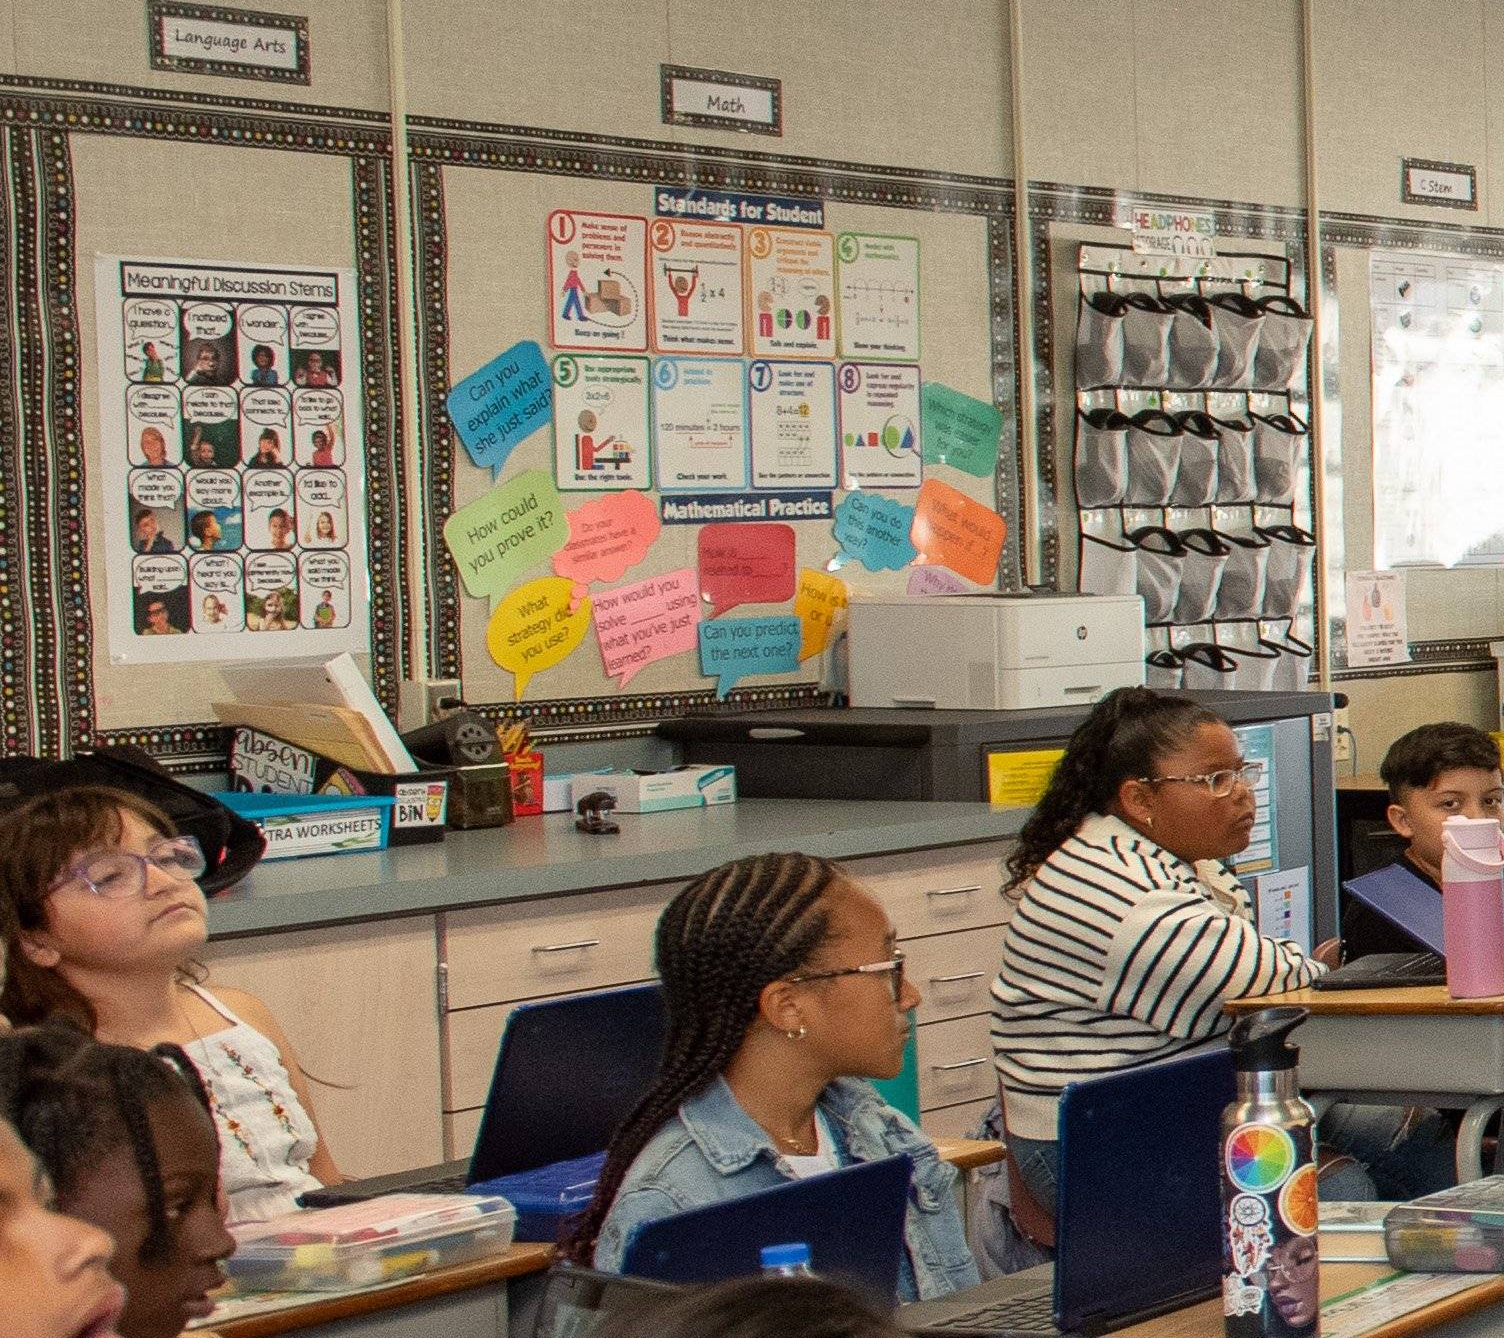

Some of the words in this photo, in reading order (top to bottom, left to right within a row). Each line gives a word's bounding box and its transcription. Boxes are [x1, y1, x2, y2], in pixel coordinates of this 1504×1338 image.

[175, 28, 248, 53] Language
[253, 37, 286, 54] Arts
[706, 94, 745, 113] Math
[658, 192, 737, 218] Standards
[740, 200, 763, 219] for
[765, 202, 823, 225] Student
[559, 216, 566, 238] 1
[656, 224, 669, 246] 2
[754, 230, 766, 254] 3
[128, 272, 211, 292] Meaningful
[213, 277, 287, 295] Discussion
[289, 281, 334, 298] Stems
[468, 379, 495, 401] Can
[496, 362, 520, 387] you
[558, 362, 571, 381] 5
[658, 363, 669, 384] 6
[755, 366, 765, 387] 7
[844, 368, 856, 390] 8
[468, 394, 511, 432] explain
[511, 371, 543, 401] what
[475, 432, 497, 454] she
[497, 412, 523, 442] just
[523, 388, 552, 420] said?
[467, 520, 499, 545] How
[500, 493, 539, 526] could
[663, 499, 766, 521] Mathematical
[769, 497, 829, 517] Practice
[851, 496, 870, 517] Can
[870, 507, 889, 527] you
[469, 551, 496, 575] you
[496, 525, 534, 559] prove
[537, 510, 554, 532] it?
[517, 595, 549, 618] What
[592, 595, 620, 612] How
[622, 587, 655, 606] would
[659, 578, 680, 598] you
[598, 613, 627, 632] solve
[665, 593, 698, 612] using
[507, 616, 552, 647] strategy
[602, 633, 630, 652] what
[631, 622, 667, 644] you've
[669, 613, 692, 636] just
[703, 624, 728, 640] Can
[730, 624, 753, 640] you
[754, 620, 798, 639] predict
[521, 643, 544, 662] you
[545, 626, 570, 650] use?
[710, 645, 730, 660] the
[732, 645, 759, 660] next
[763, 641, 793, 659] one?
[296, 818, 382, 839] WORKSHEETS
